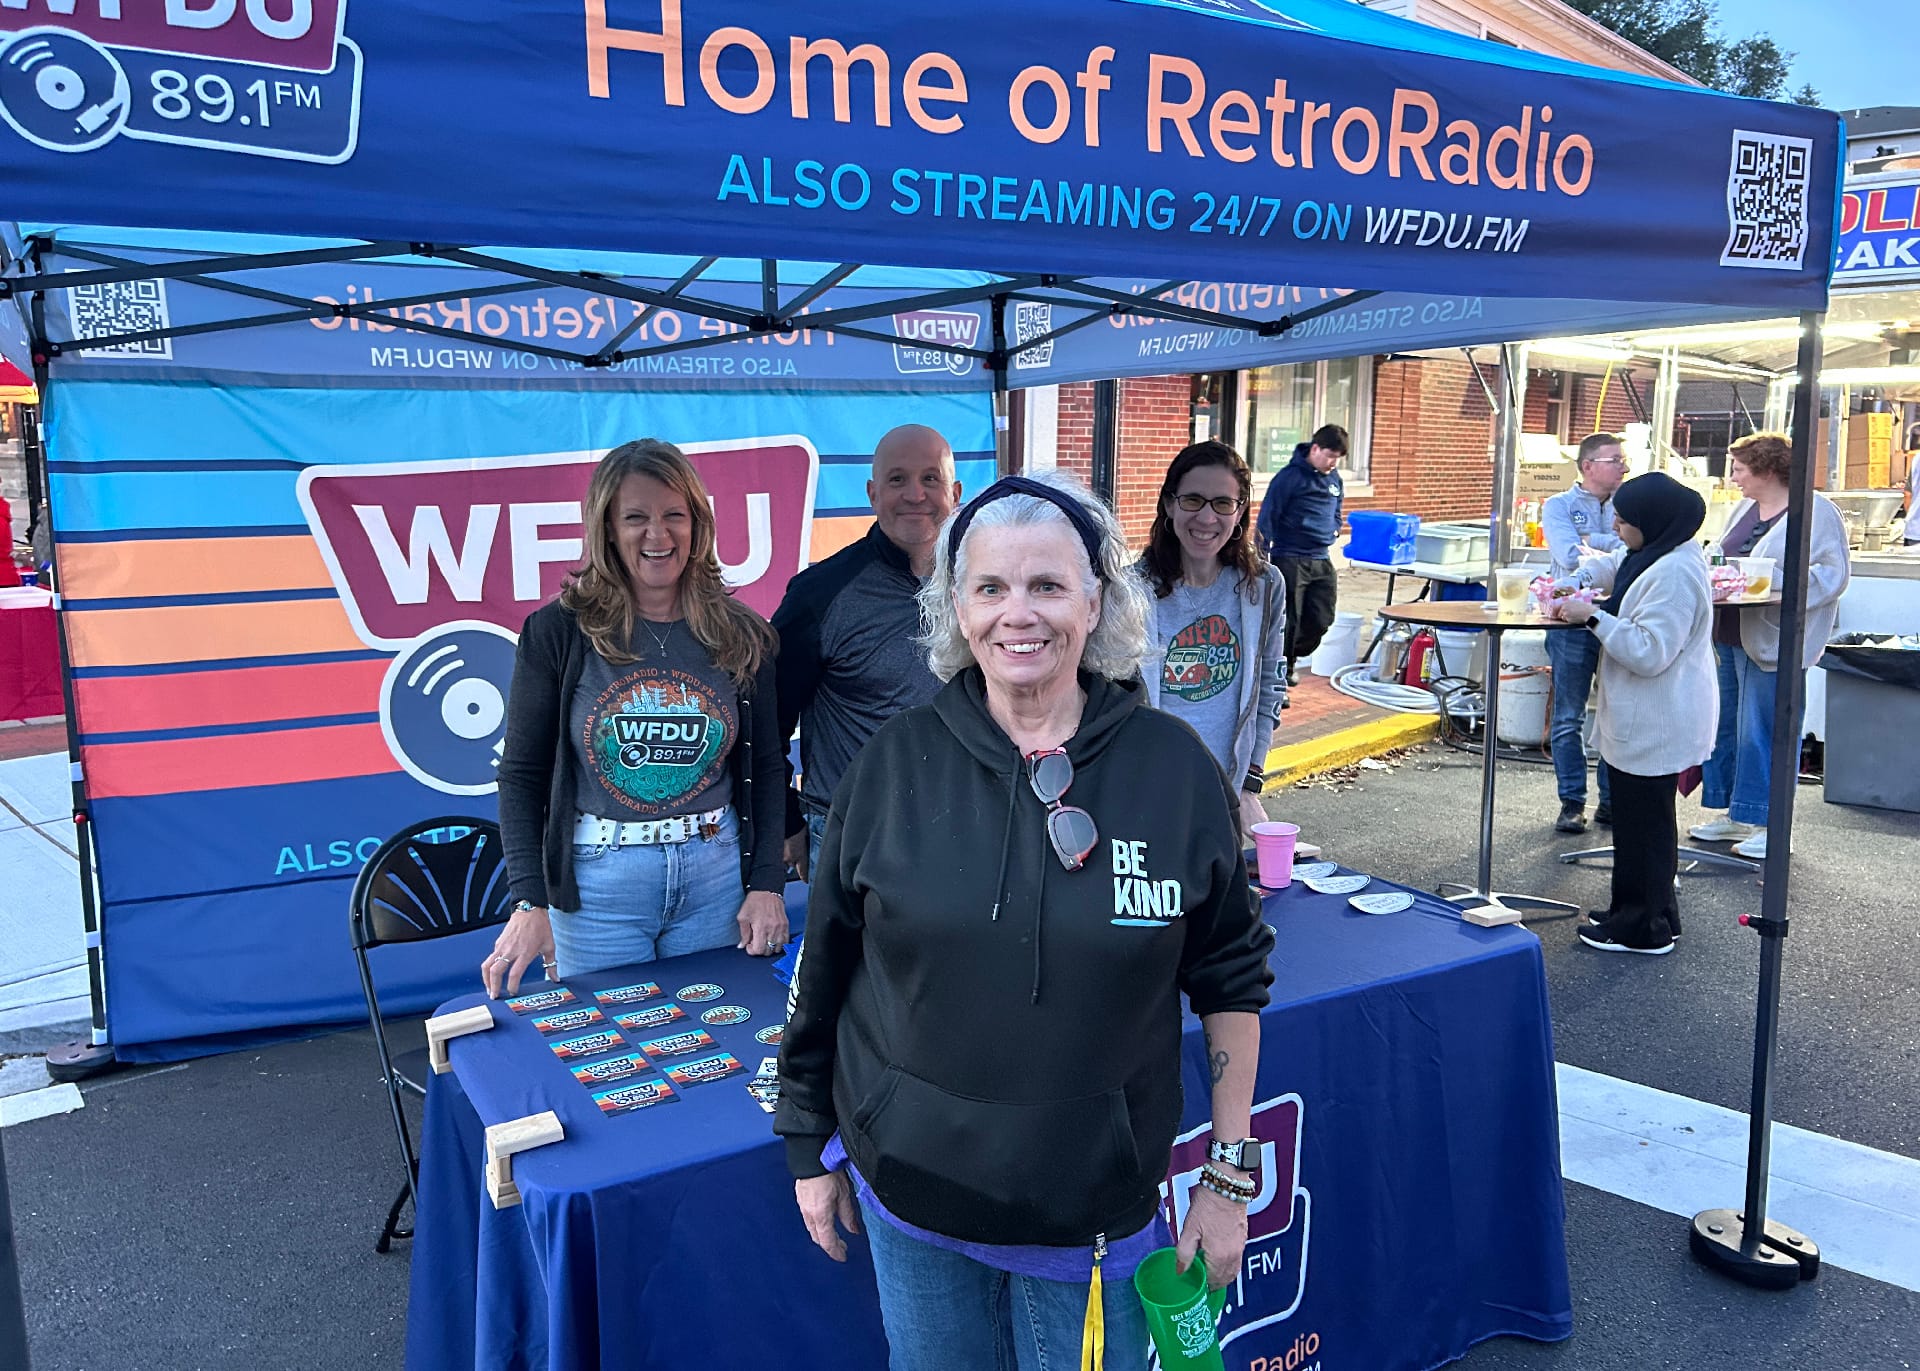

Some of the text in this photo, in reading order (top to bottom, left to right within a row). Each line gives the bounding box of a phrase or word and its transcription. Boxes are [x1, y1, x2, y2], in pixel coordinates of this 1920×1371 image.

[584, 0, 1594, 196] Home of RetroRadio
[717, 155, 1529, 253] ALSO STREAMING 24/7 ON WFDU.FM
[1835, 237, 1920, 269] AK
[352, 493, 773, 605] WFU
[1176, 617, 1230, 646] WFDU
[1207, 646, 1235, 667] 89.1
[1210, 663, 1234, 684] FM
[597, 668, 716, 704] RETRORADIO WFDU.FM
[620, 720, 699, 742] WFDU
[599, 775, 659, 814] RETRORADIO
[274, 836, 384, 875] ALSO
[1111, 838, 1147, 877] BE
